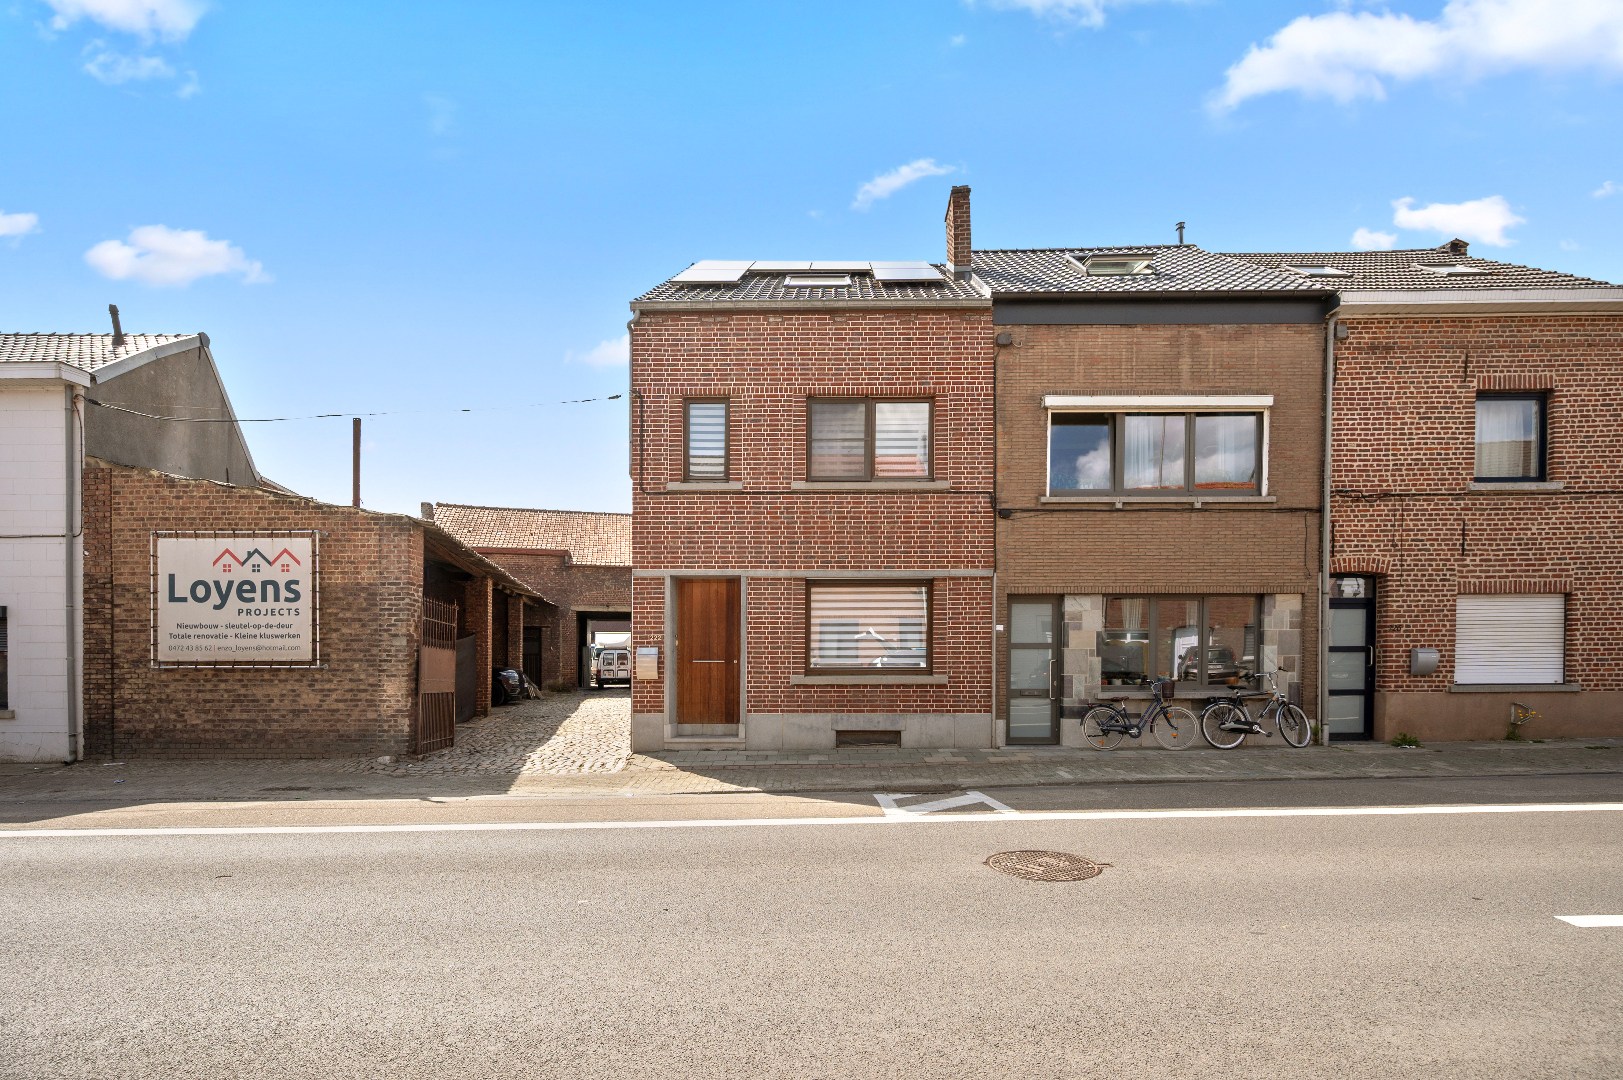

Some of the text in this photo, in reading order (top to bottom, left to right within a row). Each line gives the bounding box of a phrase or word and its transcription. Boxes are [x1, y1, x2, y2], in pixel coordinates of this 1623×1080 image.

[168, 573, 301, 610] Loyens
[237, 608, 300, 616] PROJECTS
[176, 622, 219, 630] Nieuwbouw
[224, 622, 293, 631] sleutel-op-de-deur
[168, 632, 192, 640] Totale
[193, 632, 229, 640] renovatie
[235, 632, 258, 640] Kleine
[259, 632, 301, 640] kluswerken
